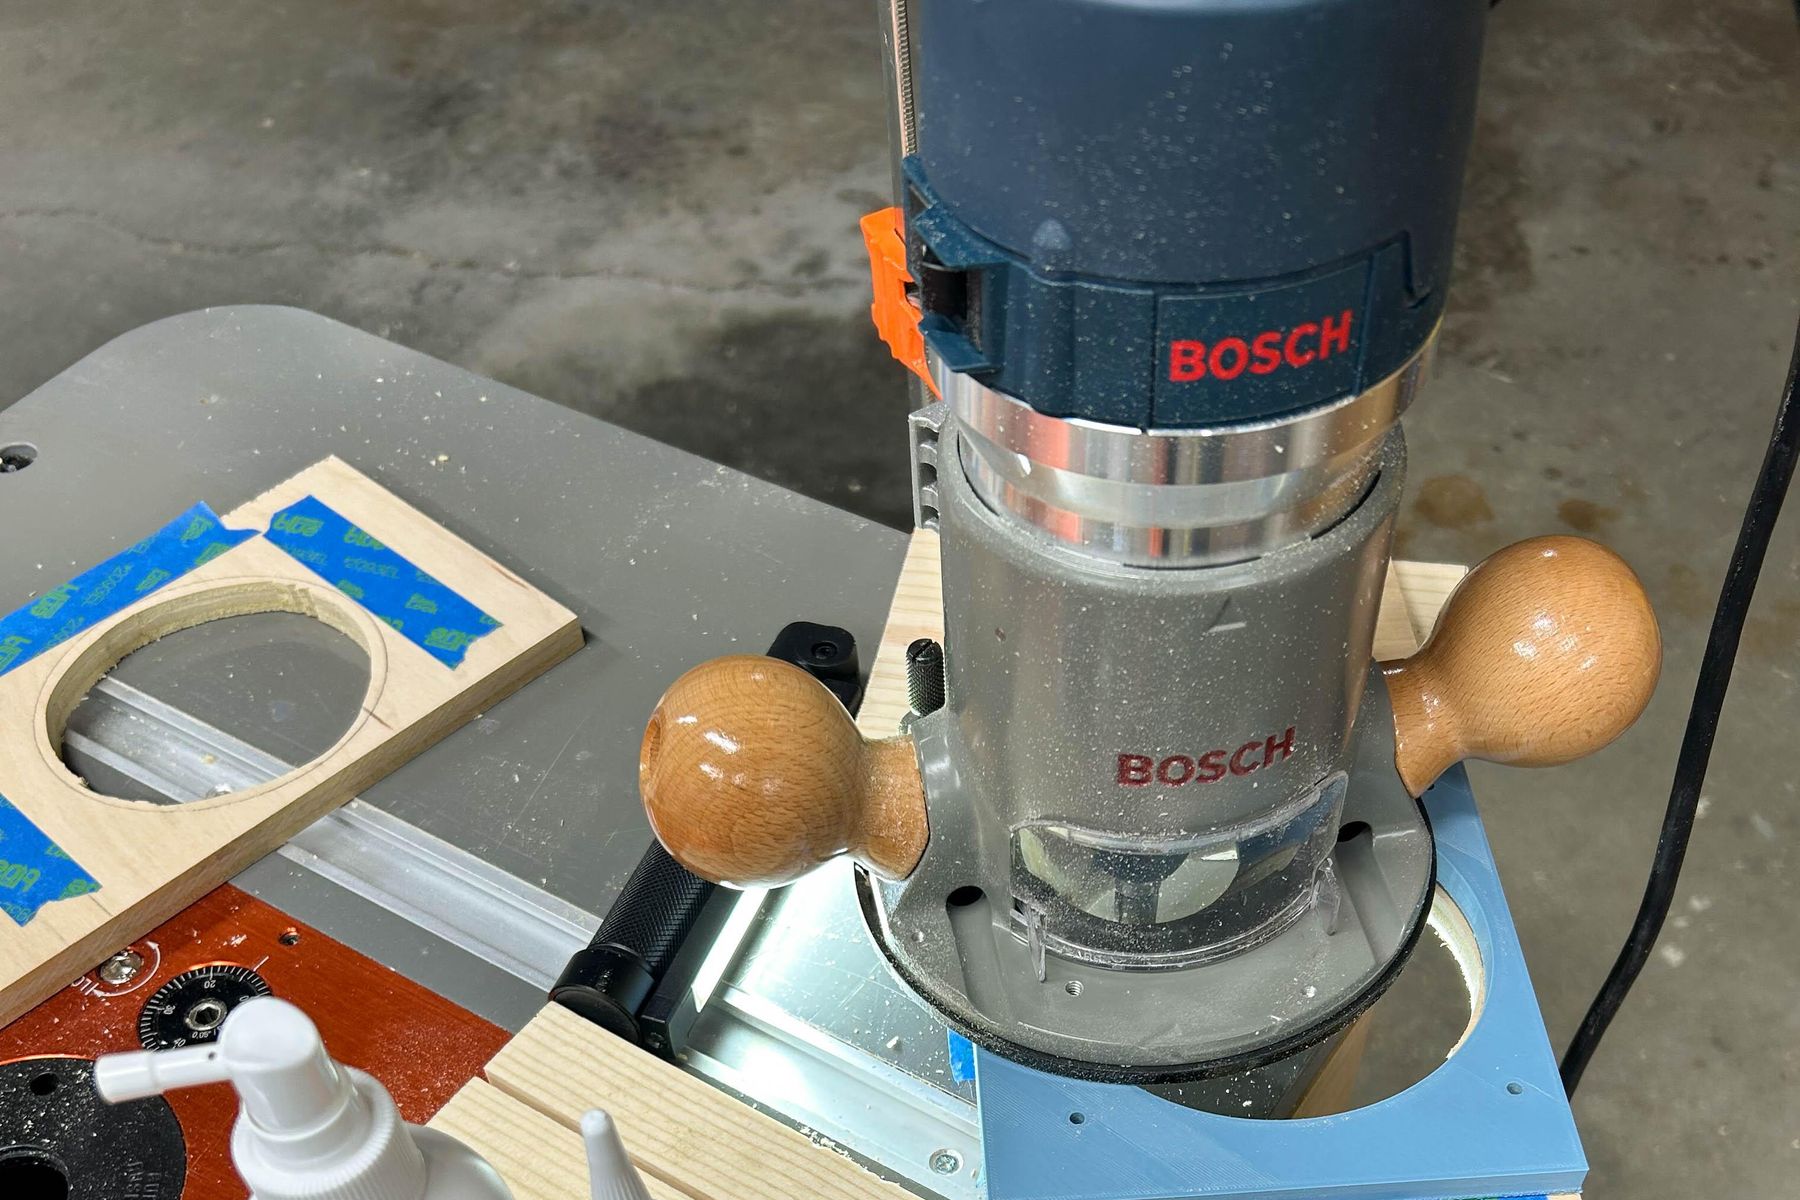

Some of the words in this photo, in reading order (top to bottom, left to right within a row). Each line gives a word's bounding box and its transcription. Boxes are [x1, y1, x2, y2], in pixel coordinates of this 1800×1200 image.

[1168, 310, 1352, 383] BOSCH
[1117, 726, 1297, 789] BOSCH
[204, 979, 216, 989] 20
